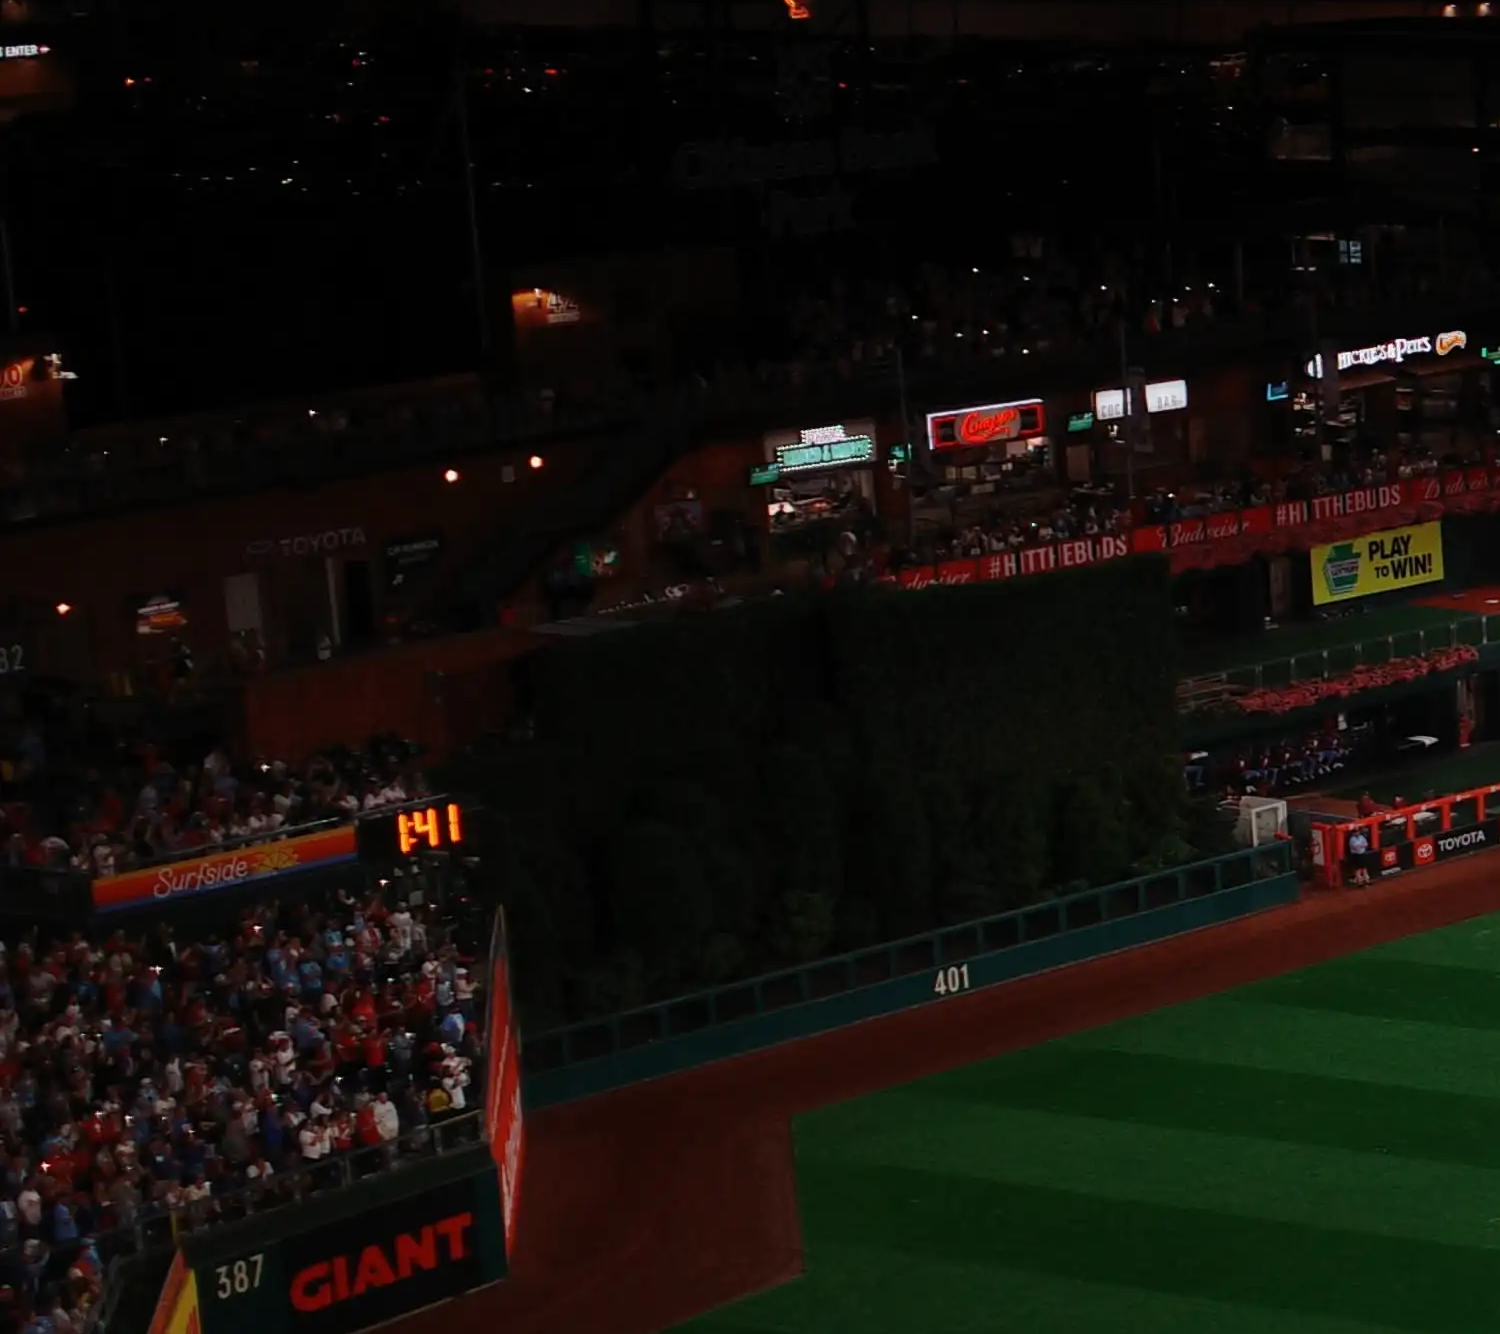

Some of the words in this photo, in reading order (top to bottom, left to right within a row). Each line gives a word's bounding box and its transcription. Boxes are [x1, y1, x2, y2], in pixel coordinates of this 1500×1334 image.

[1275, 484, 1401, 528] #HITTHEBUDS
[279, 527, 366, 557] TOYOTA
[1369, 534, 1411, 561] PLAY
[1374, 566, 1389, 578] TO
[1390, 553, 1432, 579] WIN!
[1437, 829, 1486, 852] TOYOTA
[154, 857, 250, 899] Surfside
[934, 962, 969, 995] 401
[215, 1253, 264, 1300] 387
[289, 1211, 473, 1313] GIANT
